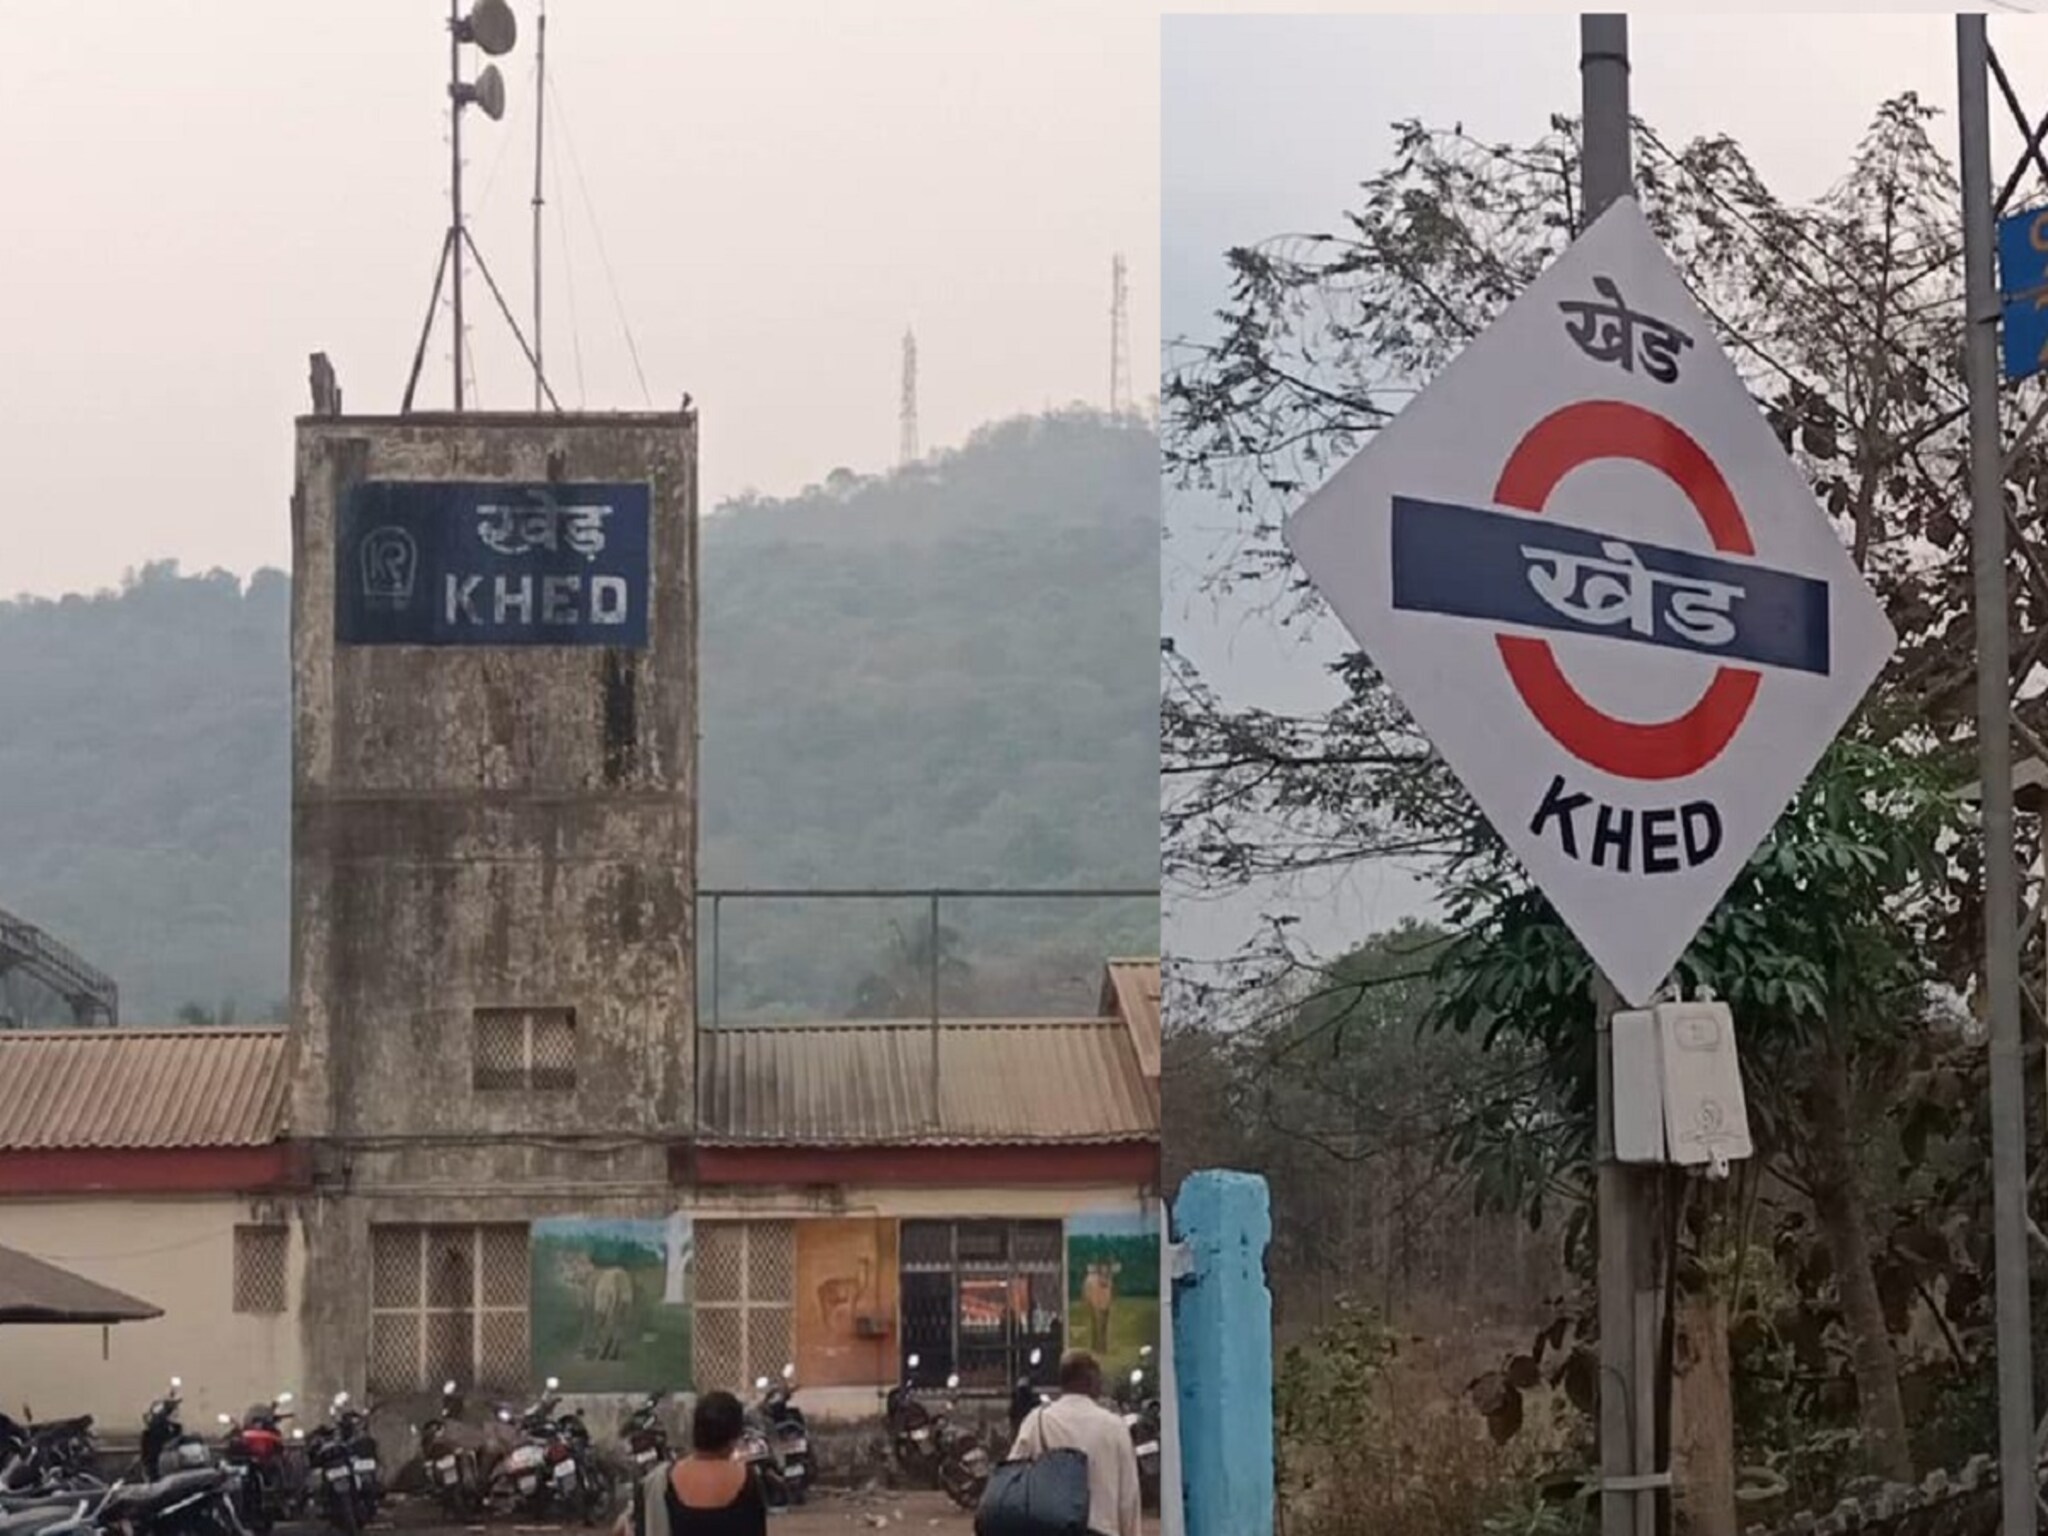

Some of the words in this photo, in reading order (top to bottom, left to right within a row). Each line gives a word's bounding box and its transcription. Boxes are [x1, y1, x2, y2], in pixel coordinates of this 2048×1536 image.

[1558, 275, 1694, 384] खेड
[445, 574, 627, 625] KHED
[1520, 541, 1746, 646] खेड
[1530, 774, 1723, 874] KHED
